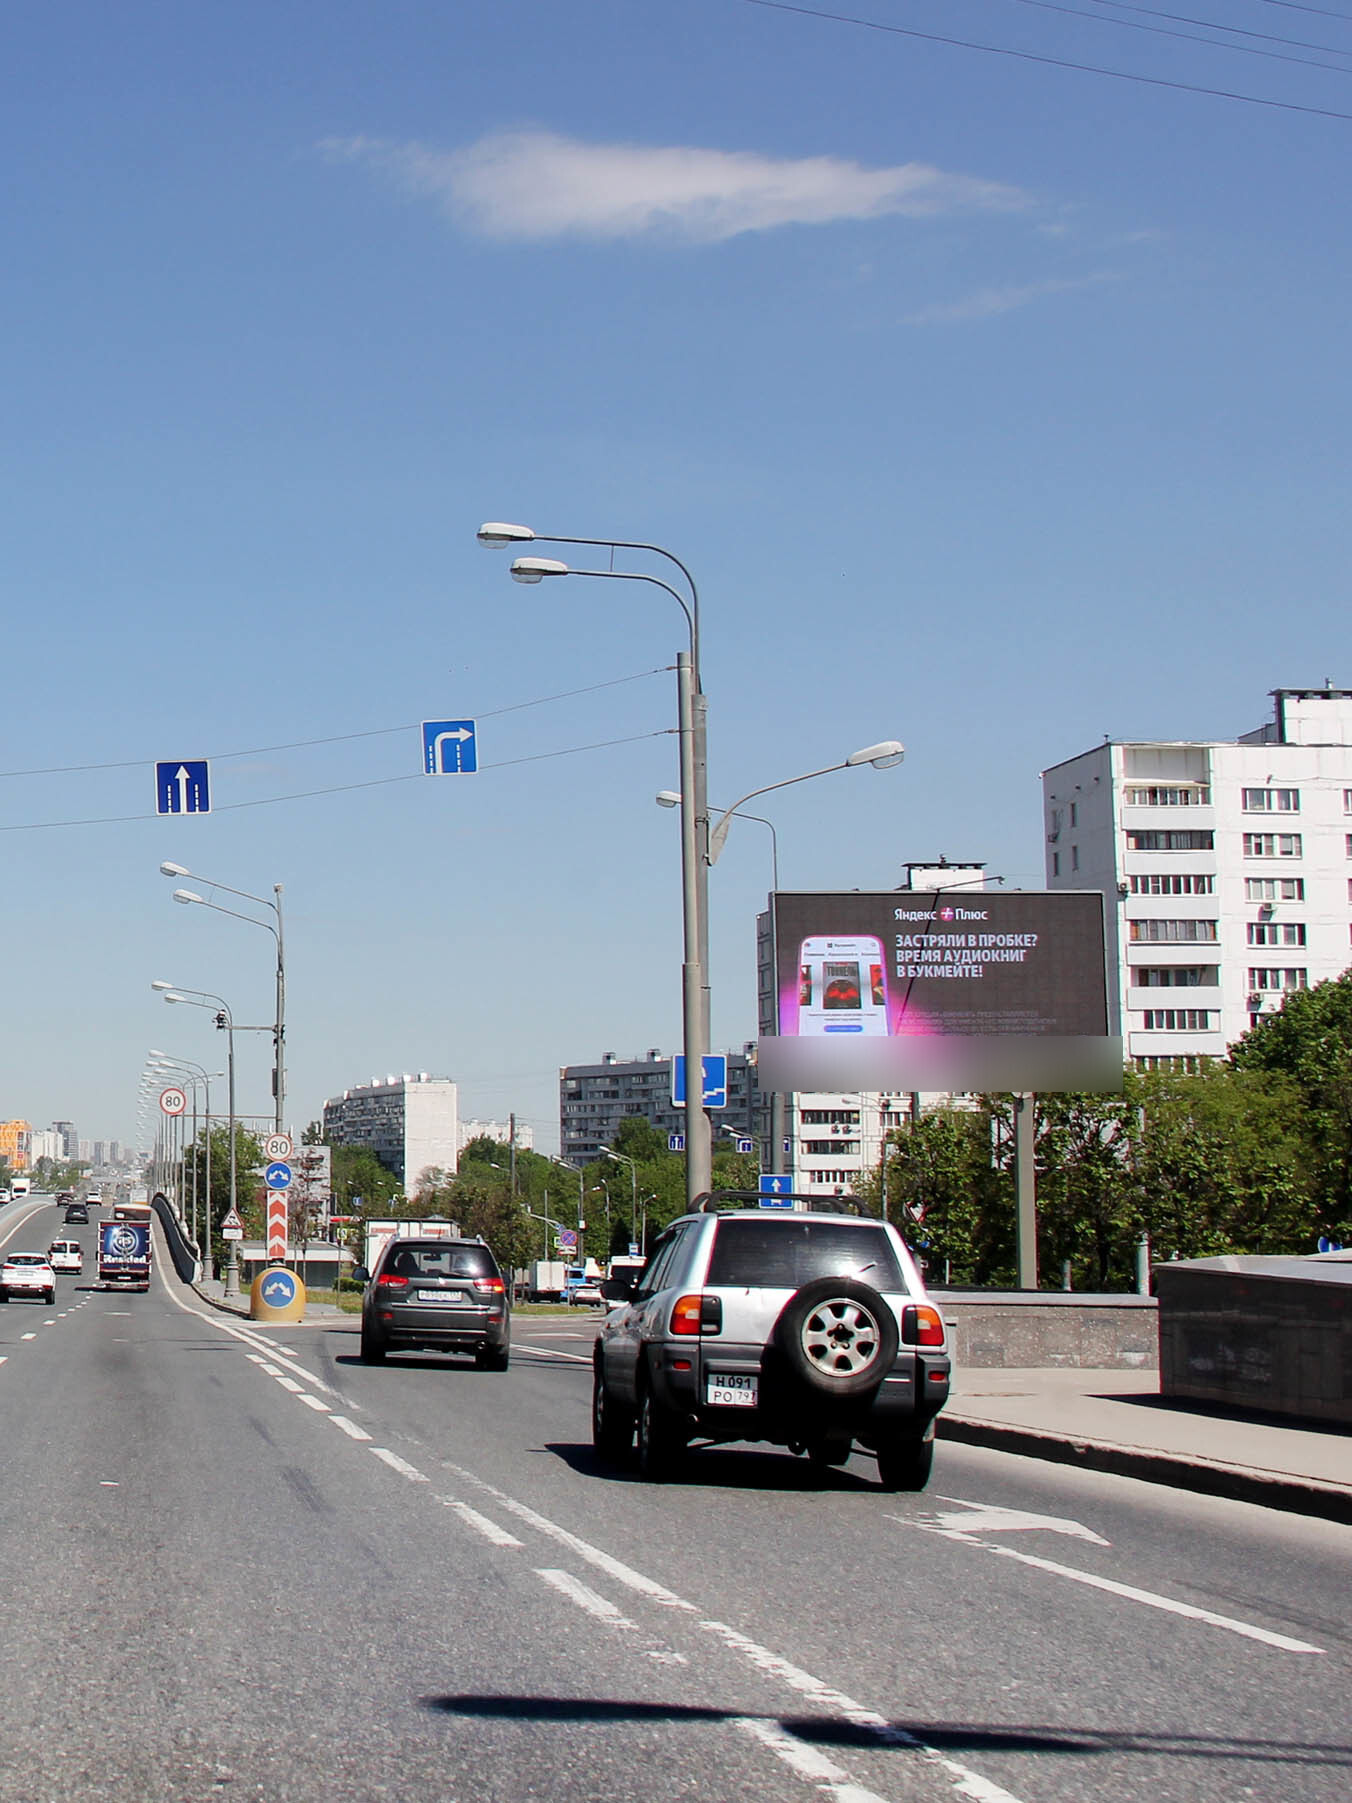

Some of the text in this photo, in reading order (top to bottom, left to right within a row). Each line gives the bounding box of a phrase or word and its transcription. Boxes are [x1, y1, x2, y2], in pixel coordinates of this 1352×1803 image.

[894, 908, 988, 921] Яндекс Плюс
[895, 934, 1038, 947] ЗАСТРЯЛИ В ПРОБКЕ?
[896, 950, 1026, 964] ВРЕМЯ АУДИОКНИГ
[897, 963, 983, 977] В БУКМЕЙТЕ!
[165, 1096, 181, 1107] 80
[270, 1141, 288, 1153] 80
